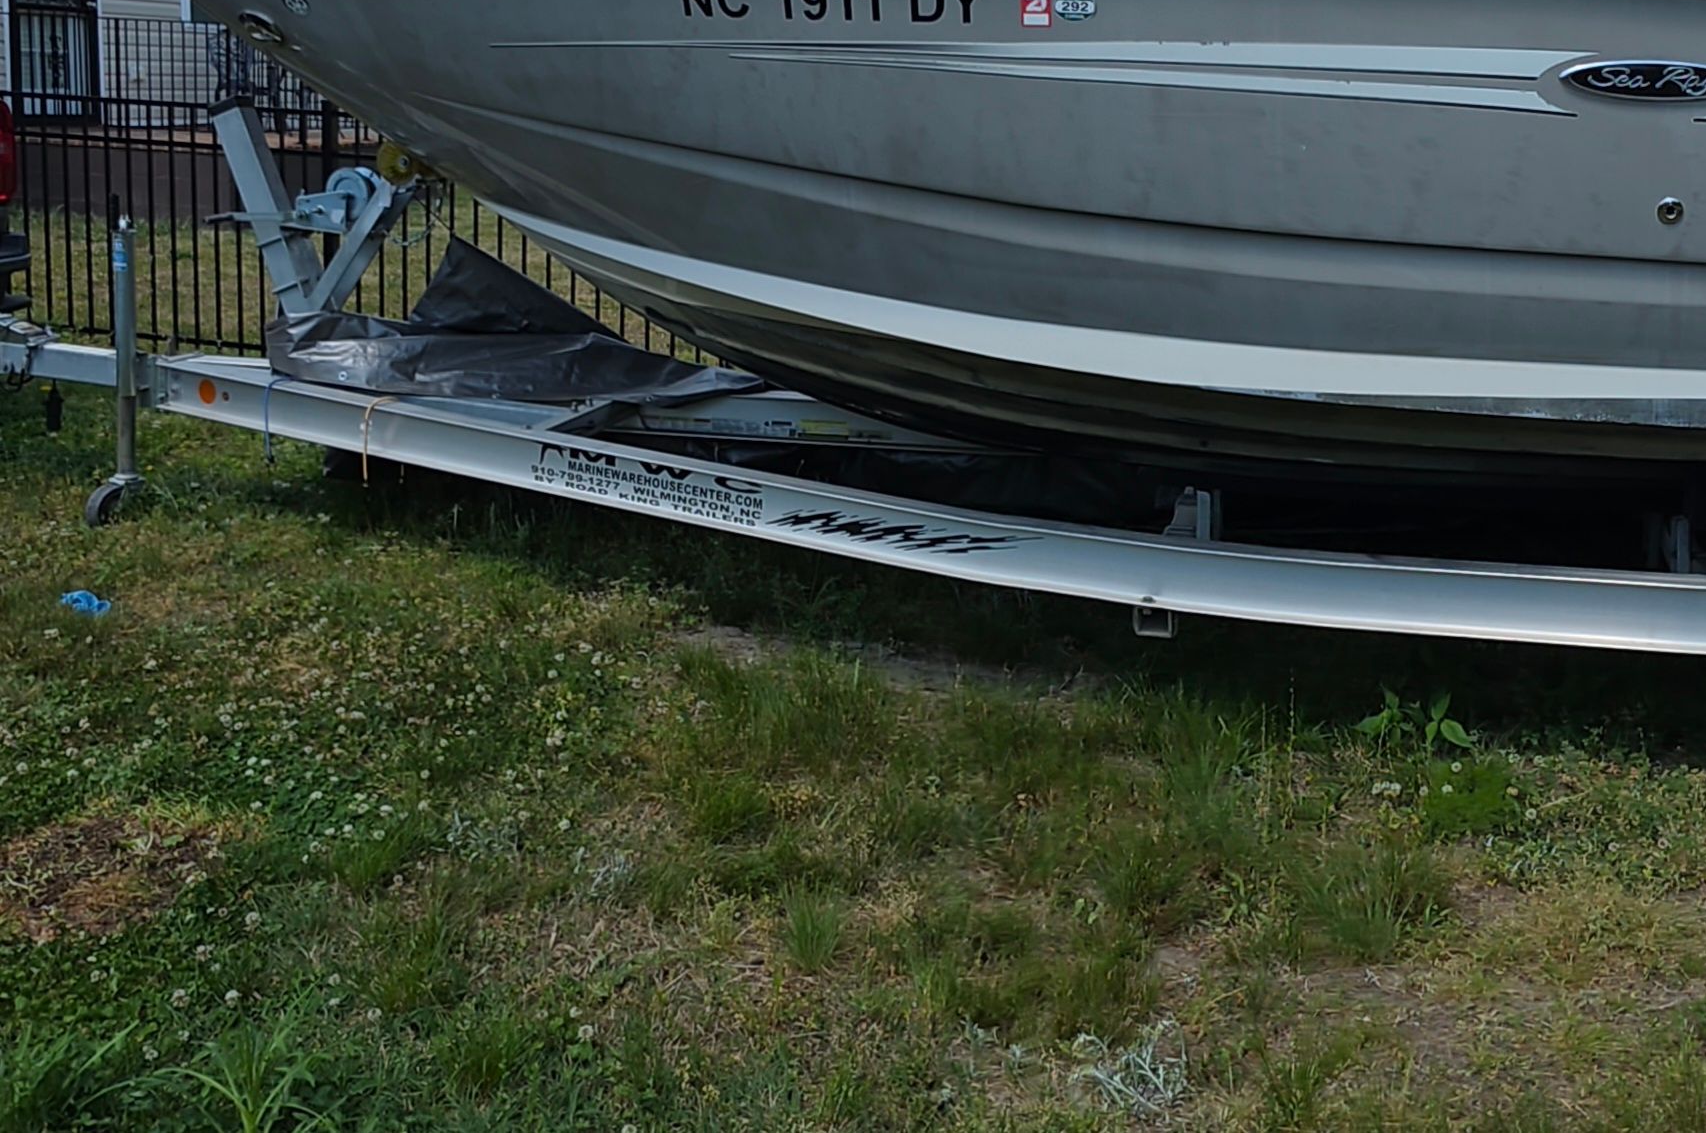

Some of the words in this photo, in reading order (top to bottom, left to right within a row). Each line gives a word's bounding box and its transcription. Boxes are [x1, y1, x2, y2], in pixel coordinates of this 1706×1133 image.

[1061, 1, 1089, 12] 292
[1588, 67, 1650, 89] Sea
[531, 465, 620, 490] 910-799-1277
[567, 460, 763, 510] MARINEWAREHOUSECENTER.COM
[534, 475, 555, 484] BY
[565, 482, 608, 496] ROAD
[619, 493, 660, 507] KING
[671, 503, 757, 527] TRAILERS
[633, 486, 735, 516] WILMINGTON,
[740, 508, 762, 520] NC
